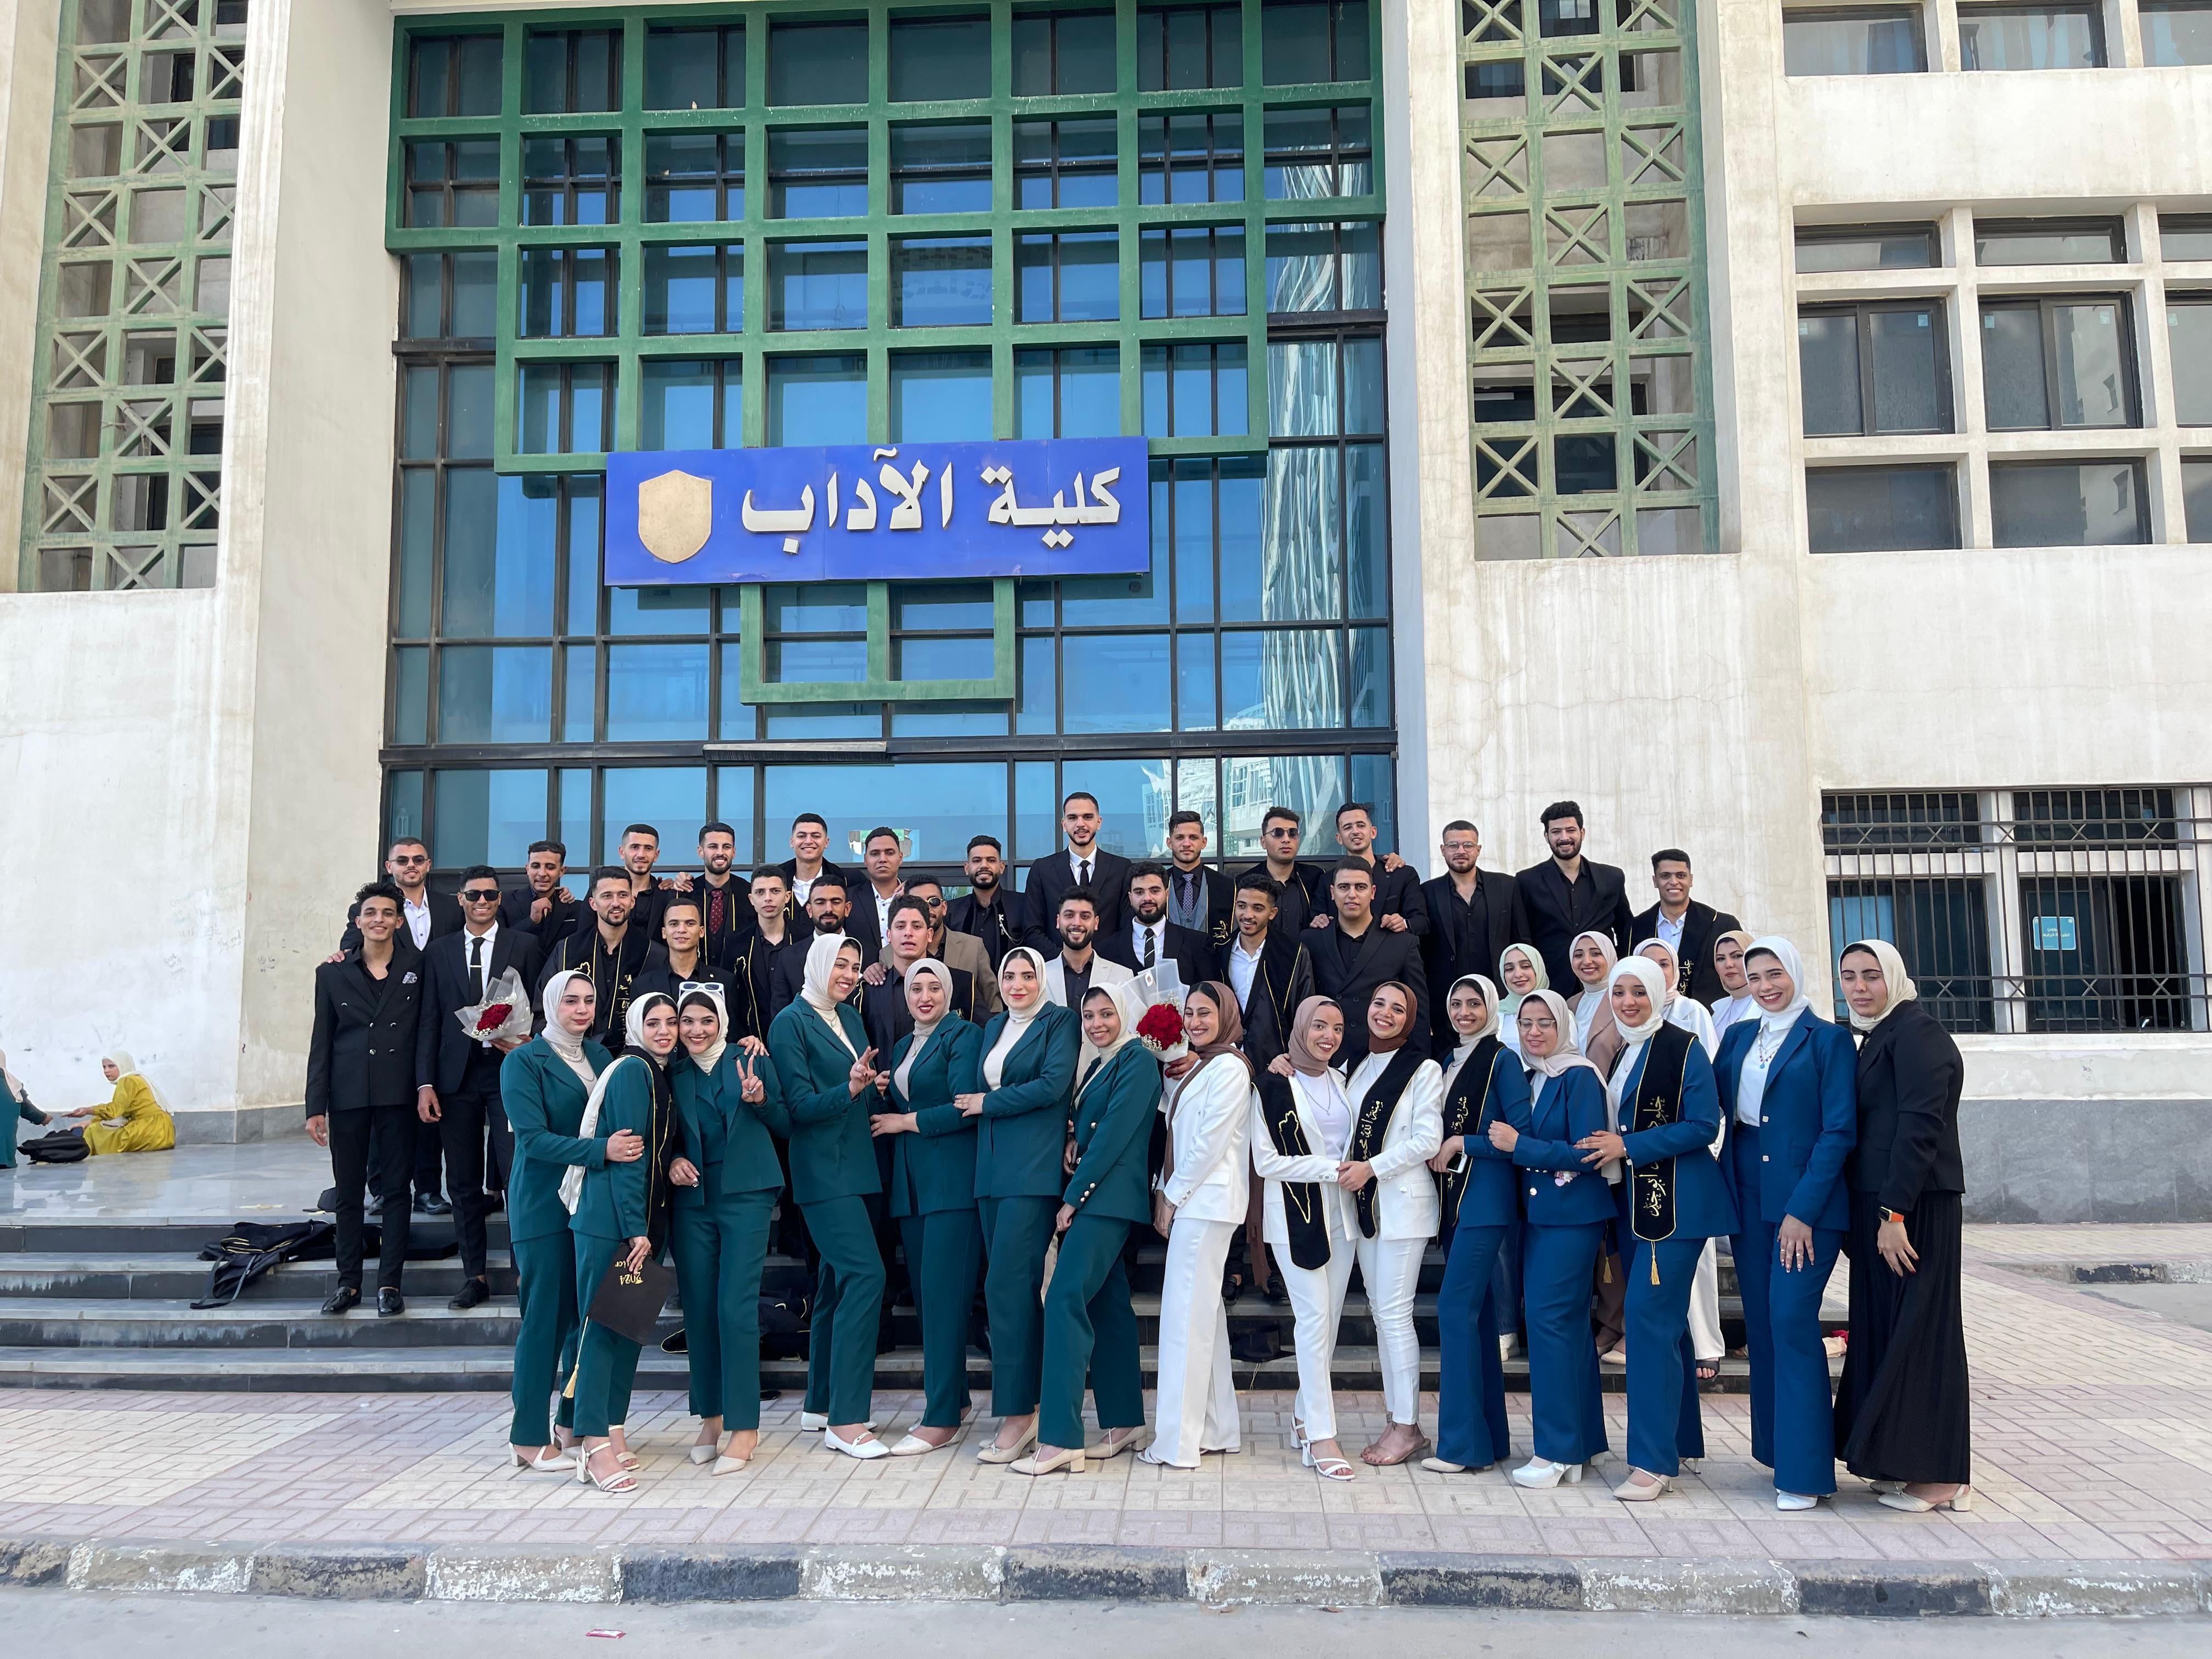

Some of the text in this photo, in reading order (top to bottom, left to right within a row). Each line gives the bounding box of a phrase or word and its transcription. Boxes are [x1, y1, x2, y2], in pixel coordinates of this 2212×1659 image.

[741, 446, 1122, 555] كلية الآداب
[1451, 1096, 1468, 1135] شروق
[1643, 1096, 1668, 1128] خلود
[1360, 1118, 1373, 1138] الله
[1359, 1138, 1369, 1160] محمو
[619, 1272, 644, 1285] 2024
